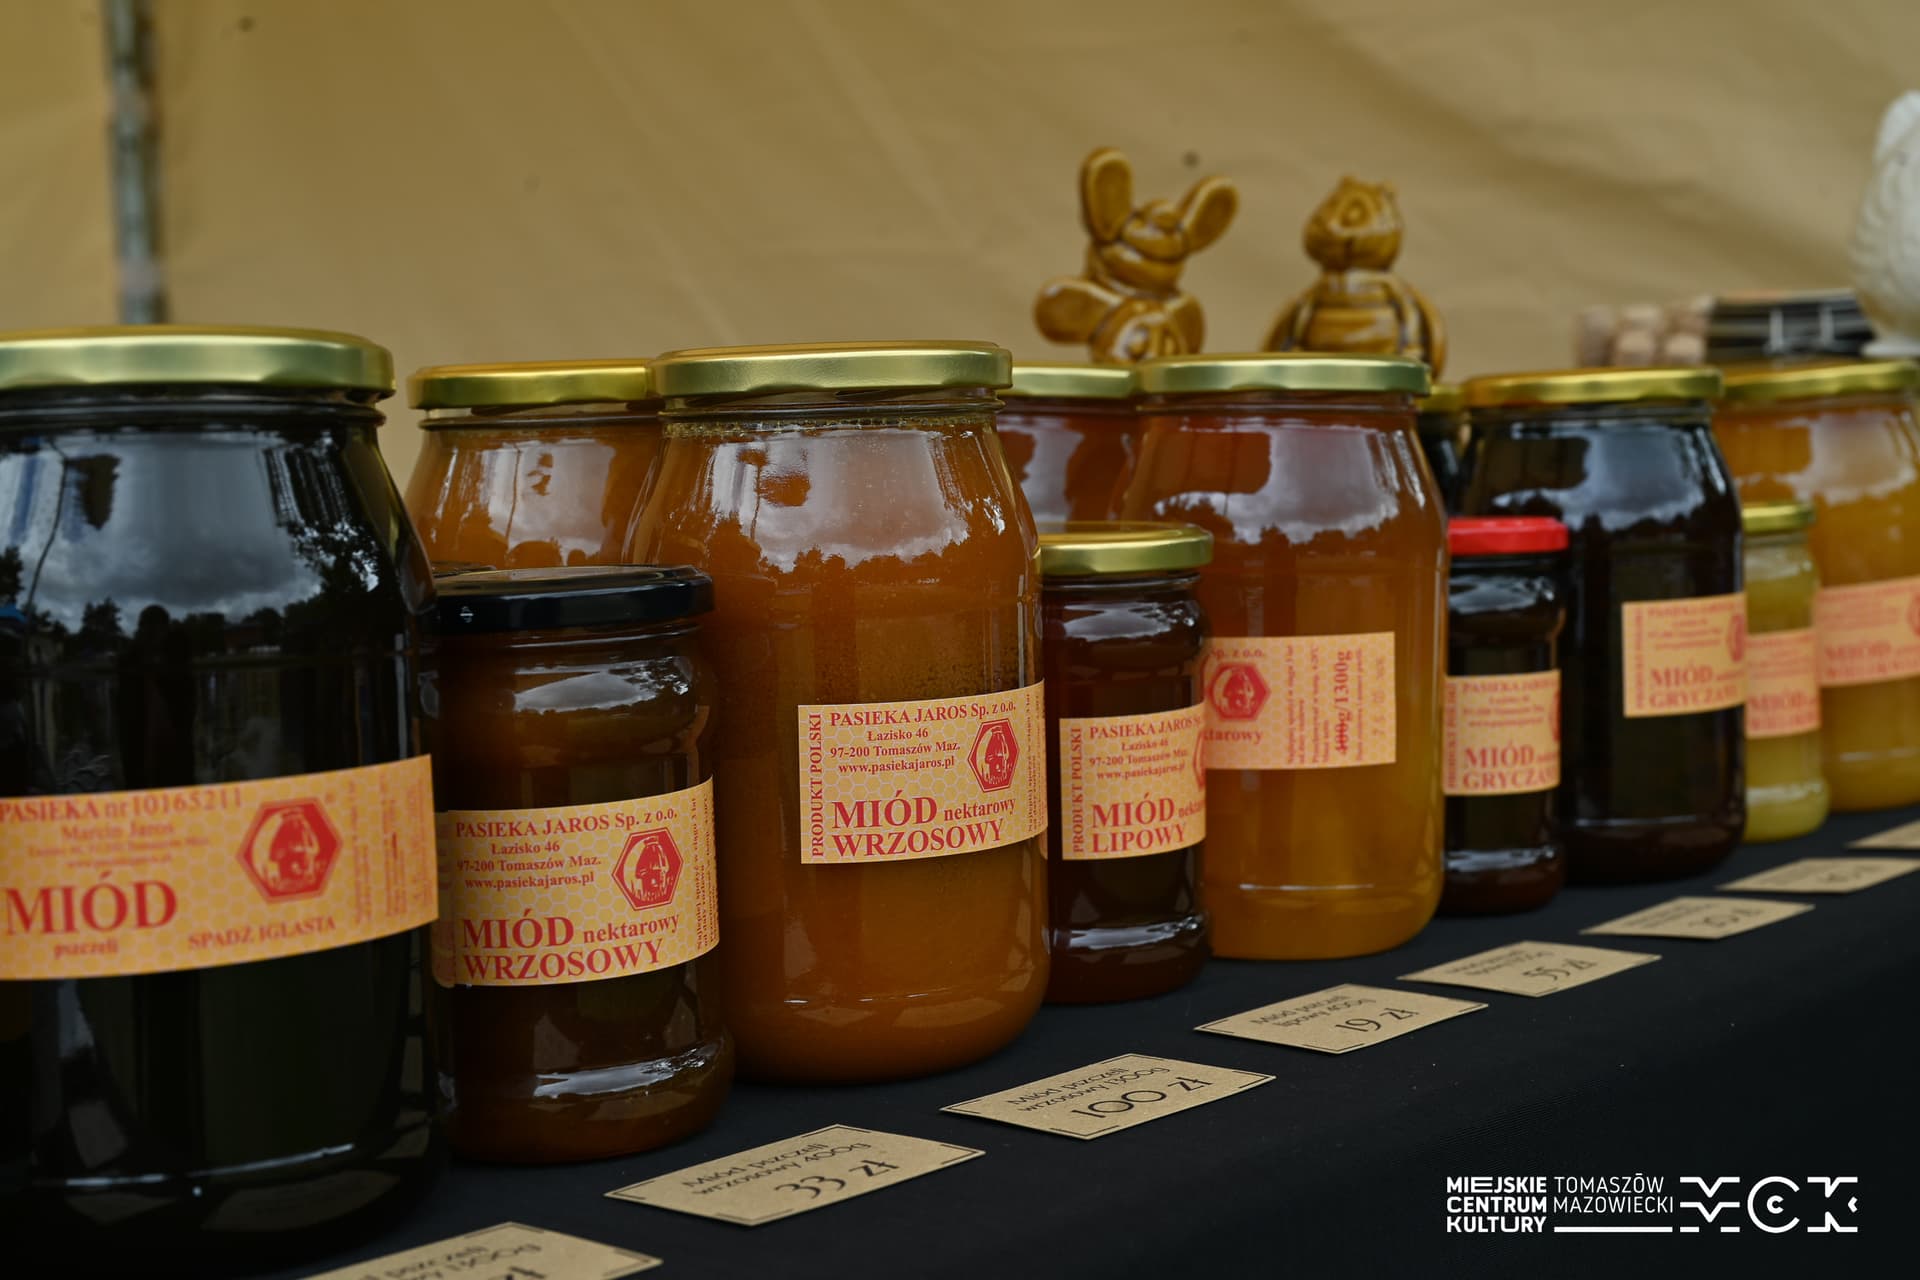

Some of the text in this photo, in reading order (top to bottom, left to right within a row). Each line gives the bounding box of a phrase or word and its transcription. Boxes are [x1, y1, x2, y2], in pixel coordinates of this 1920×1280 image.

[830, 701, 1016, 726] PASIEKA JAROS Sp. z o.o.
[867, 729, 929, 741] Łazisko 46
[1090, 723, 1155, 740] PASIEKA
[1158, 718, 1192, 733] JAROS
[830, 741, 961, 758] 97-200 Tomaszów Maz.
[1089, 756, 1124, 766] 97-200
[1465, 739, 1534, 768] MIÓD
[838, 755, 955, 775] www.pasiekajaros.pl
[808, 713, 824, 857] PRODUKT POLSKI
[1071, 728, 1083, 853] PRODUKT POLSKI
[0, 787, 242, 824] PASIEKA nr 10165211
[832, 790, 1016, 829] MIÓD nektarowy
[1092, 792, 1174, 829] MIÓD
[456, 808, 678, 837] PASIEKA JAROS Sp. z o.o.
[490, 840, 560, 855] Łazisko 46
[832, 818, 1004, 858] WRZOSOWY
[1092, 822, 1187, 853] LIPOWY
[457, 854, 602, 872] 97-200 Tomaszów Maz.
[464, 872, 595, 891] www.pasiekajaros.pl
[5, 872, 177, 936] MIÓD
[259, 915, 338, 941] IGLASTA
[463, 908, 574, 949] MIÓD
[583, 913, 680, 944] nektarowy
[464, 938, 663, 980] WRZOSOWY
[1335, 1007, 1420, 1033] 19 zł
[1061, 1066, 1130, 1091] pszczeli
[1018, 1082, 1108, 1112] wrzosowy
[1071, 1076, 1213, 1119] 100 zł
[692, 1161, 800, 1196] wrzosowy
[774, 1159, 900, 1199] 33 zł
